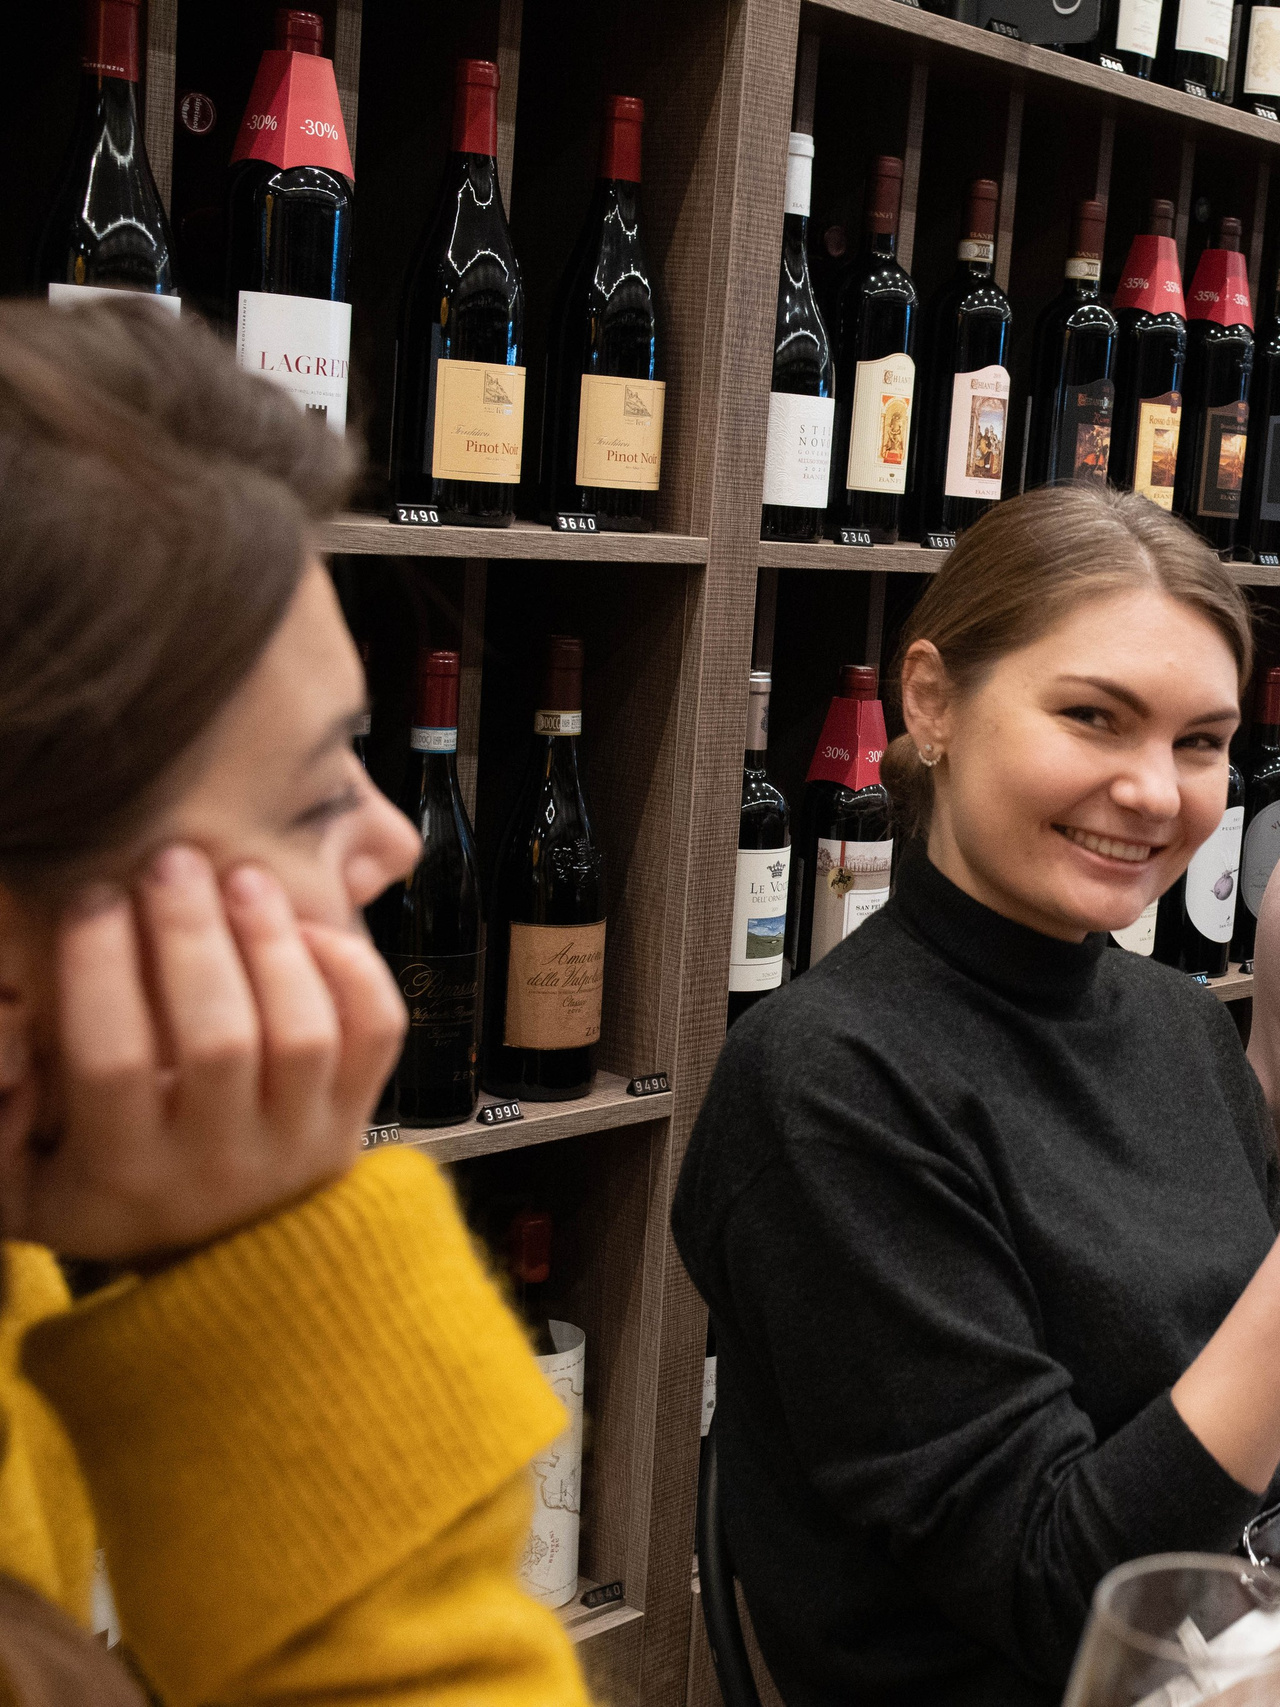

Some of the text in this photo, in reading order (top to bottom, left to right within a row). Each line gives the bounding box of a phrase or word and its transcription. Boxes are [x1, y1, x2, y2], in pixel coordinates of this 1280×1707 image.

[993, 22, 1019, 38] 1990
[246, 114, 278, 131] -30%
[300, 119, 339, 141] -30%
[1124, 277, 1149, 289] -35%
[1163, 280, 1180, 294] -35%
[1194, 290, 1220, 303] -35%
[465, 439, 519, 456] Pinot Noir
[607, 449, 658, 465] Pinot Noir
[398, 509, 439, 523] 2490
[558, 517, 596, 531] 3640
[842, 531, 871, 545] 2340
[930, 536, 956, 547] 1690
[1259, 554, 1279, 565] 6990
[822, 745, 850, 761] -30%
[527, 970, 560, 987] della
[635, 1077, 667, 1093] 9490
[485, 1103, 520, 1122] 3990
[361, 1127, 399, 1147] 5790
